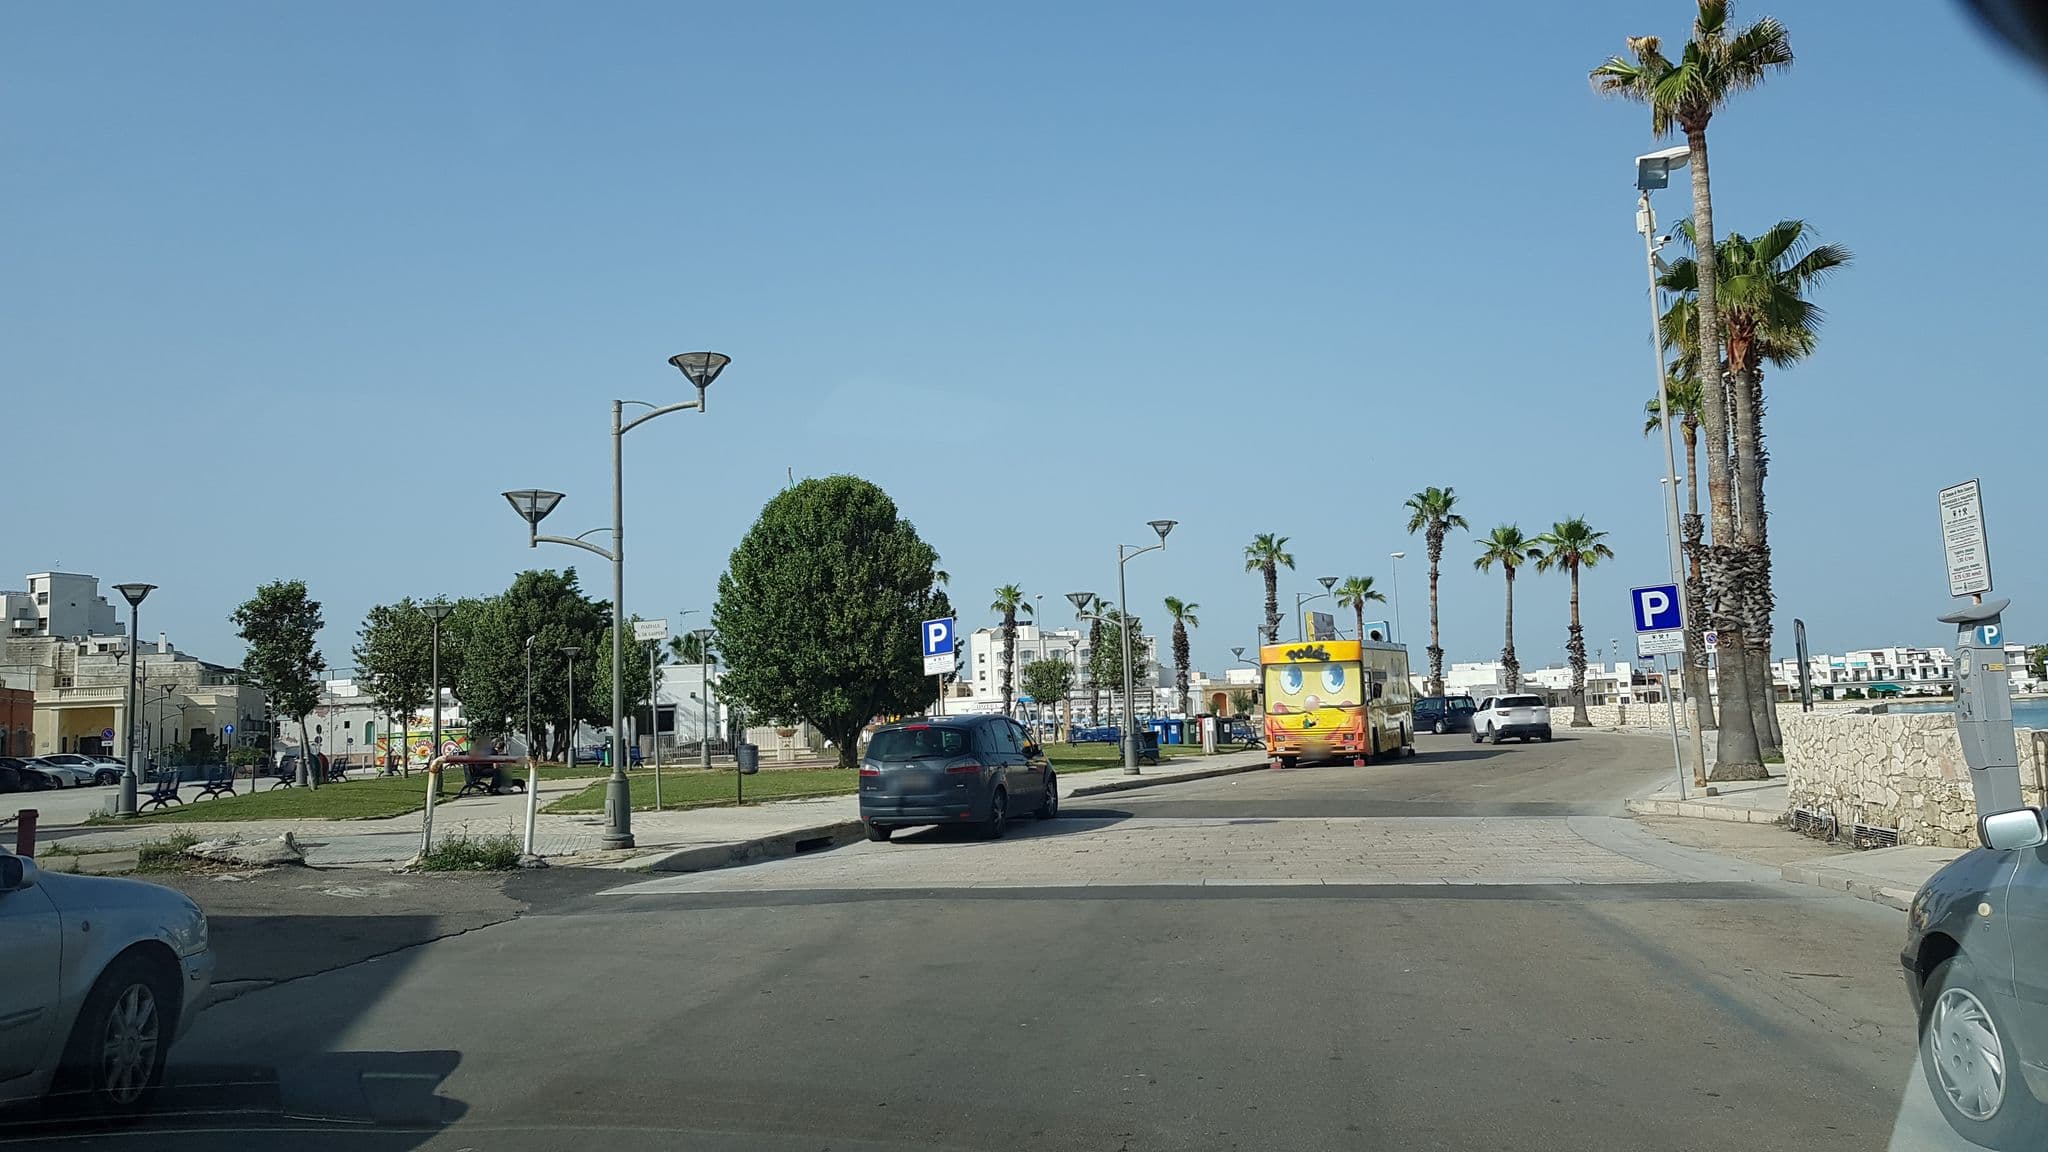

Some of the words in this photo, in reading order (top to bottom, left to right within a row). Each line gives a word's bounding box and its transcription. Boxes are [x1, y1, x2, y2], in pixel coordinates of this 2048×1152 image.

[1640, 591, 1669, 626] P
[929, 623, 947, 652] P
[1983, 625, 1998, 645] P
